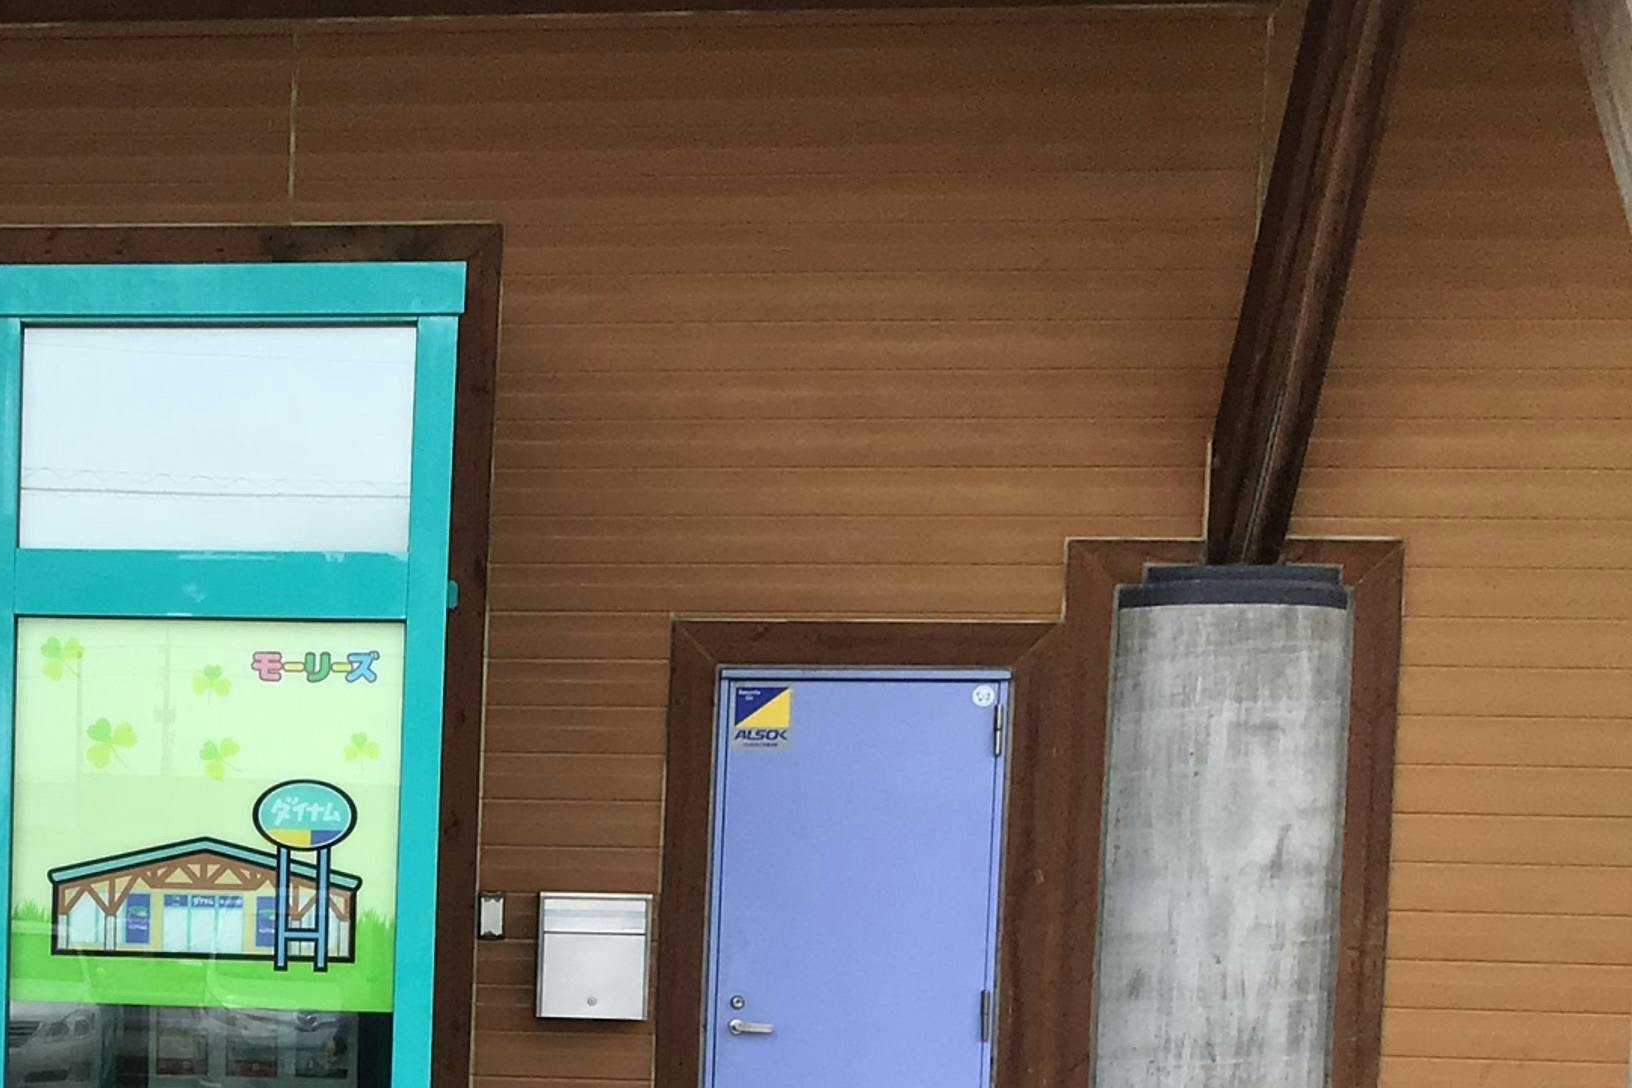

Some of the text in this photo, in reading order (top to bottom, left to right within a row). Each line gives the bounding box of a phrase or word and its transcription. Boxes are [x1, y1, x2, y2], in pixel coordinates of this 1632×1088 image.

[251, 651, 380, 683] モーリーズ
[734, 729, 788, 741] ALSOK
[271, 797, 342, 827] ダイナム
